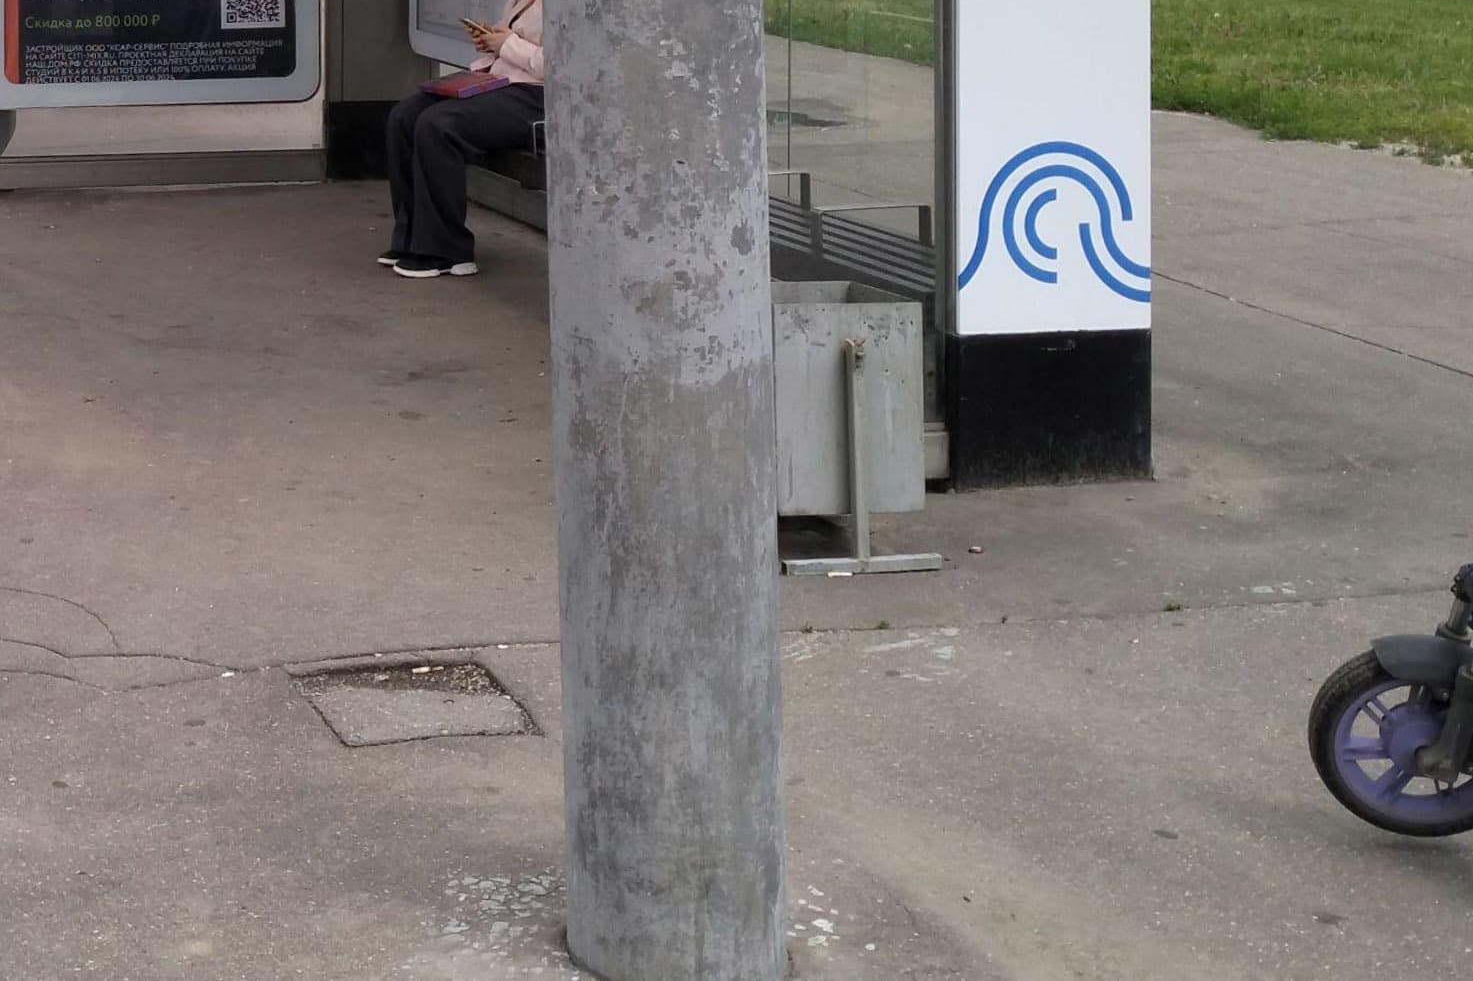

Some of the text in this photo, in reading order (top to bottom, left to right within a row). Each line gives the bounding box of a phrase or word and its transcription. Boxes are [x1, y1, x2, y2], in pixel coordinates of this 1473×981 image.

[25, 16, 73, 29] Скидка
[75, 18, 92, 29] до
[95, 15, 120, 28] 800
[123, 14, 148, 27] 000
